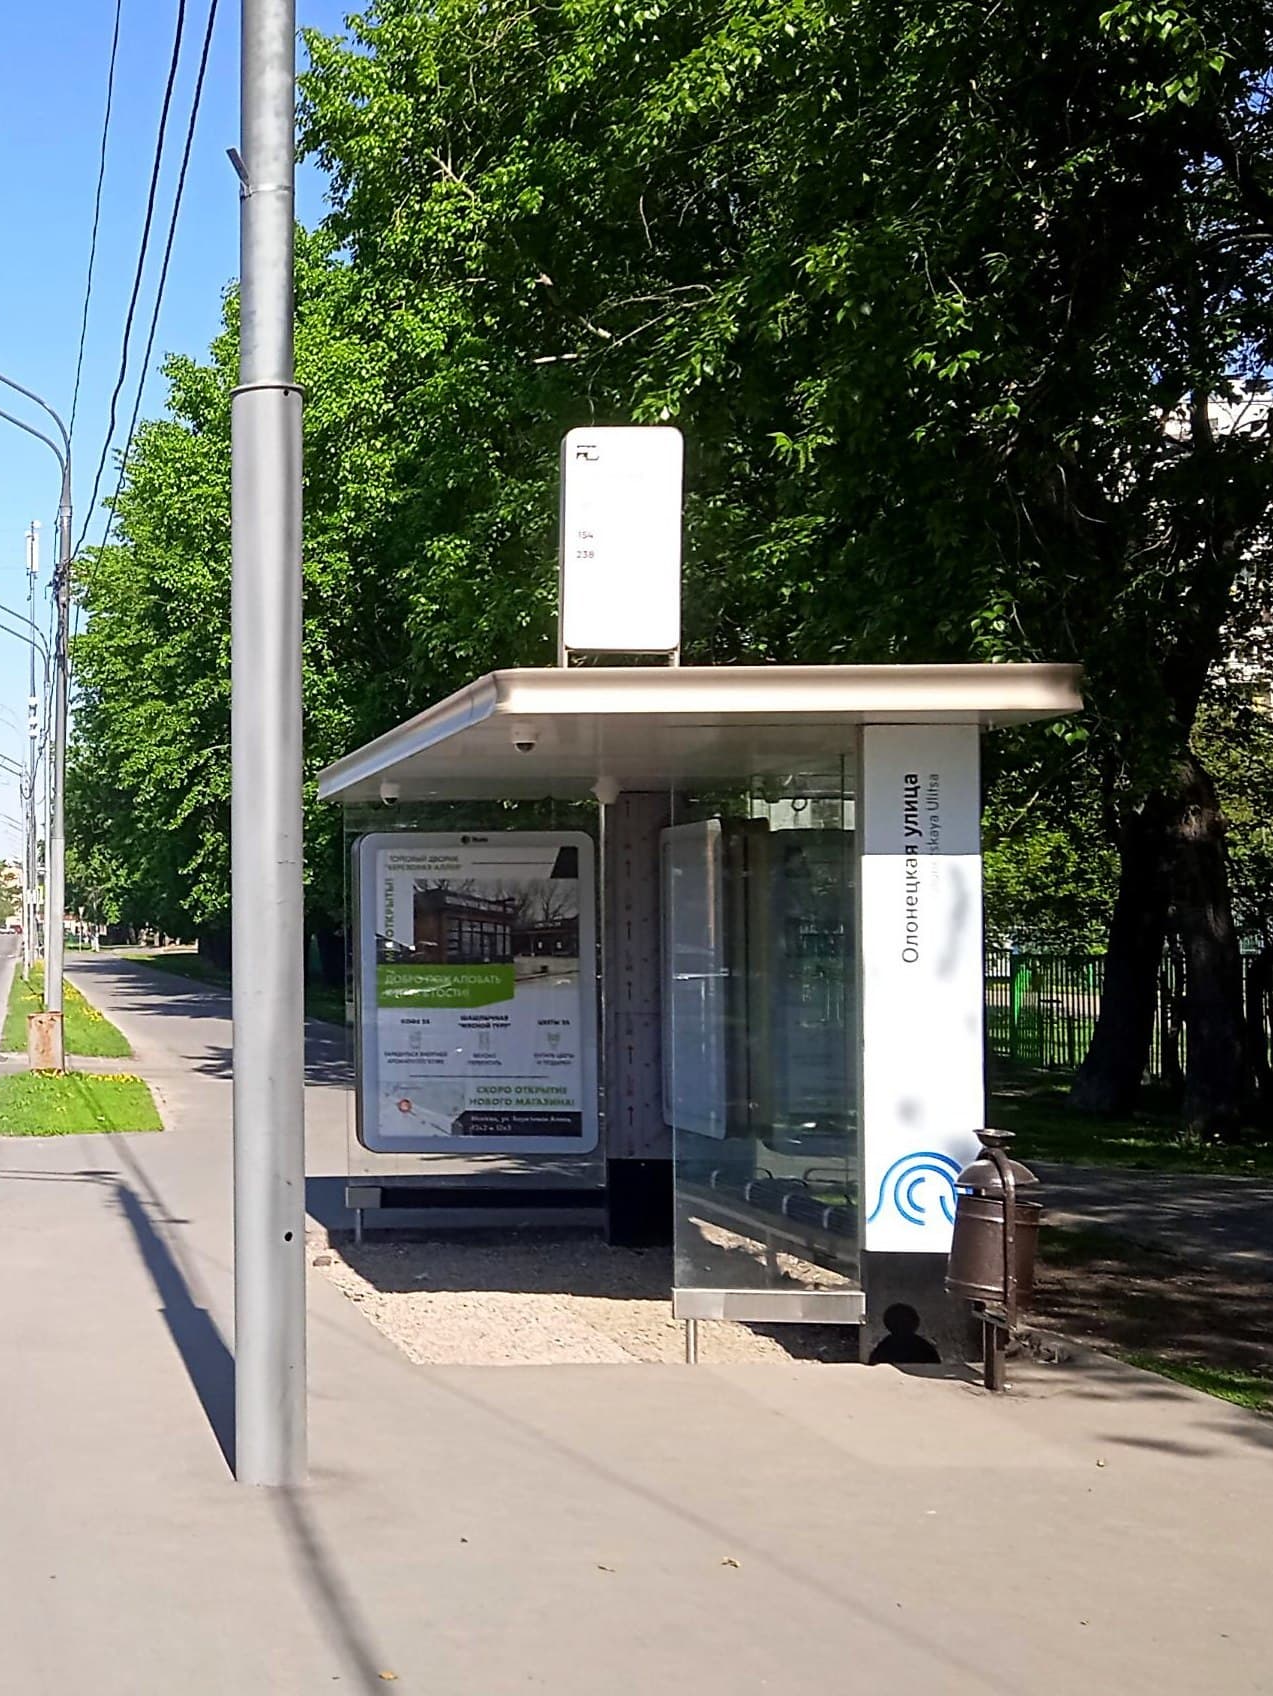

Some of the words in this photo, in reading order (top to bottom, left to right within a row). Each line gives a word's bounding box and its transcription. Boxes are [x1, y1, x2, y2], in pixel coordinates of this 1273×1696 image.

[904, 773, 923, 837] улица
[926, 773, 940, 811] Ulitsa
[902, 844, 921, 963] Олонецкая
